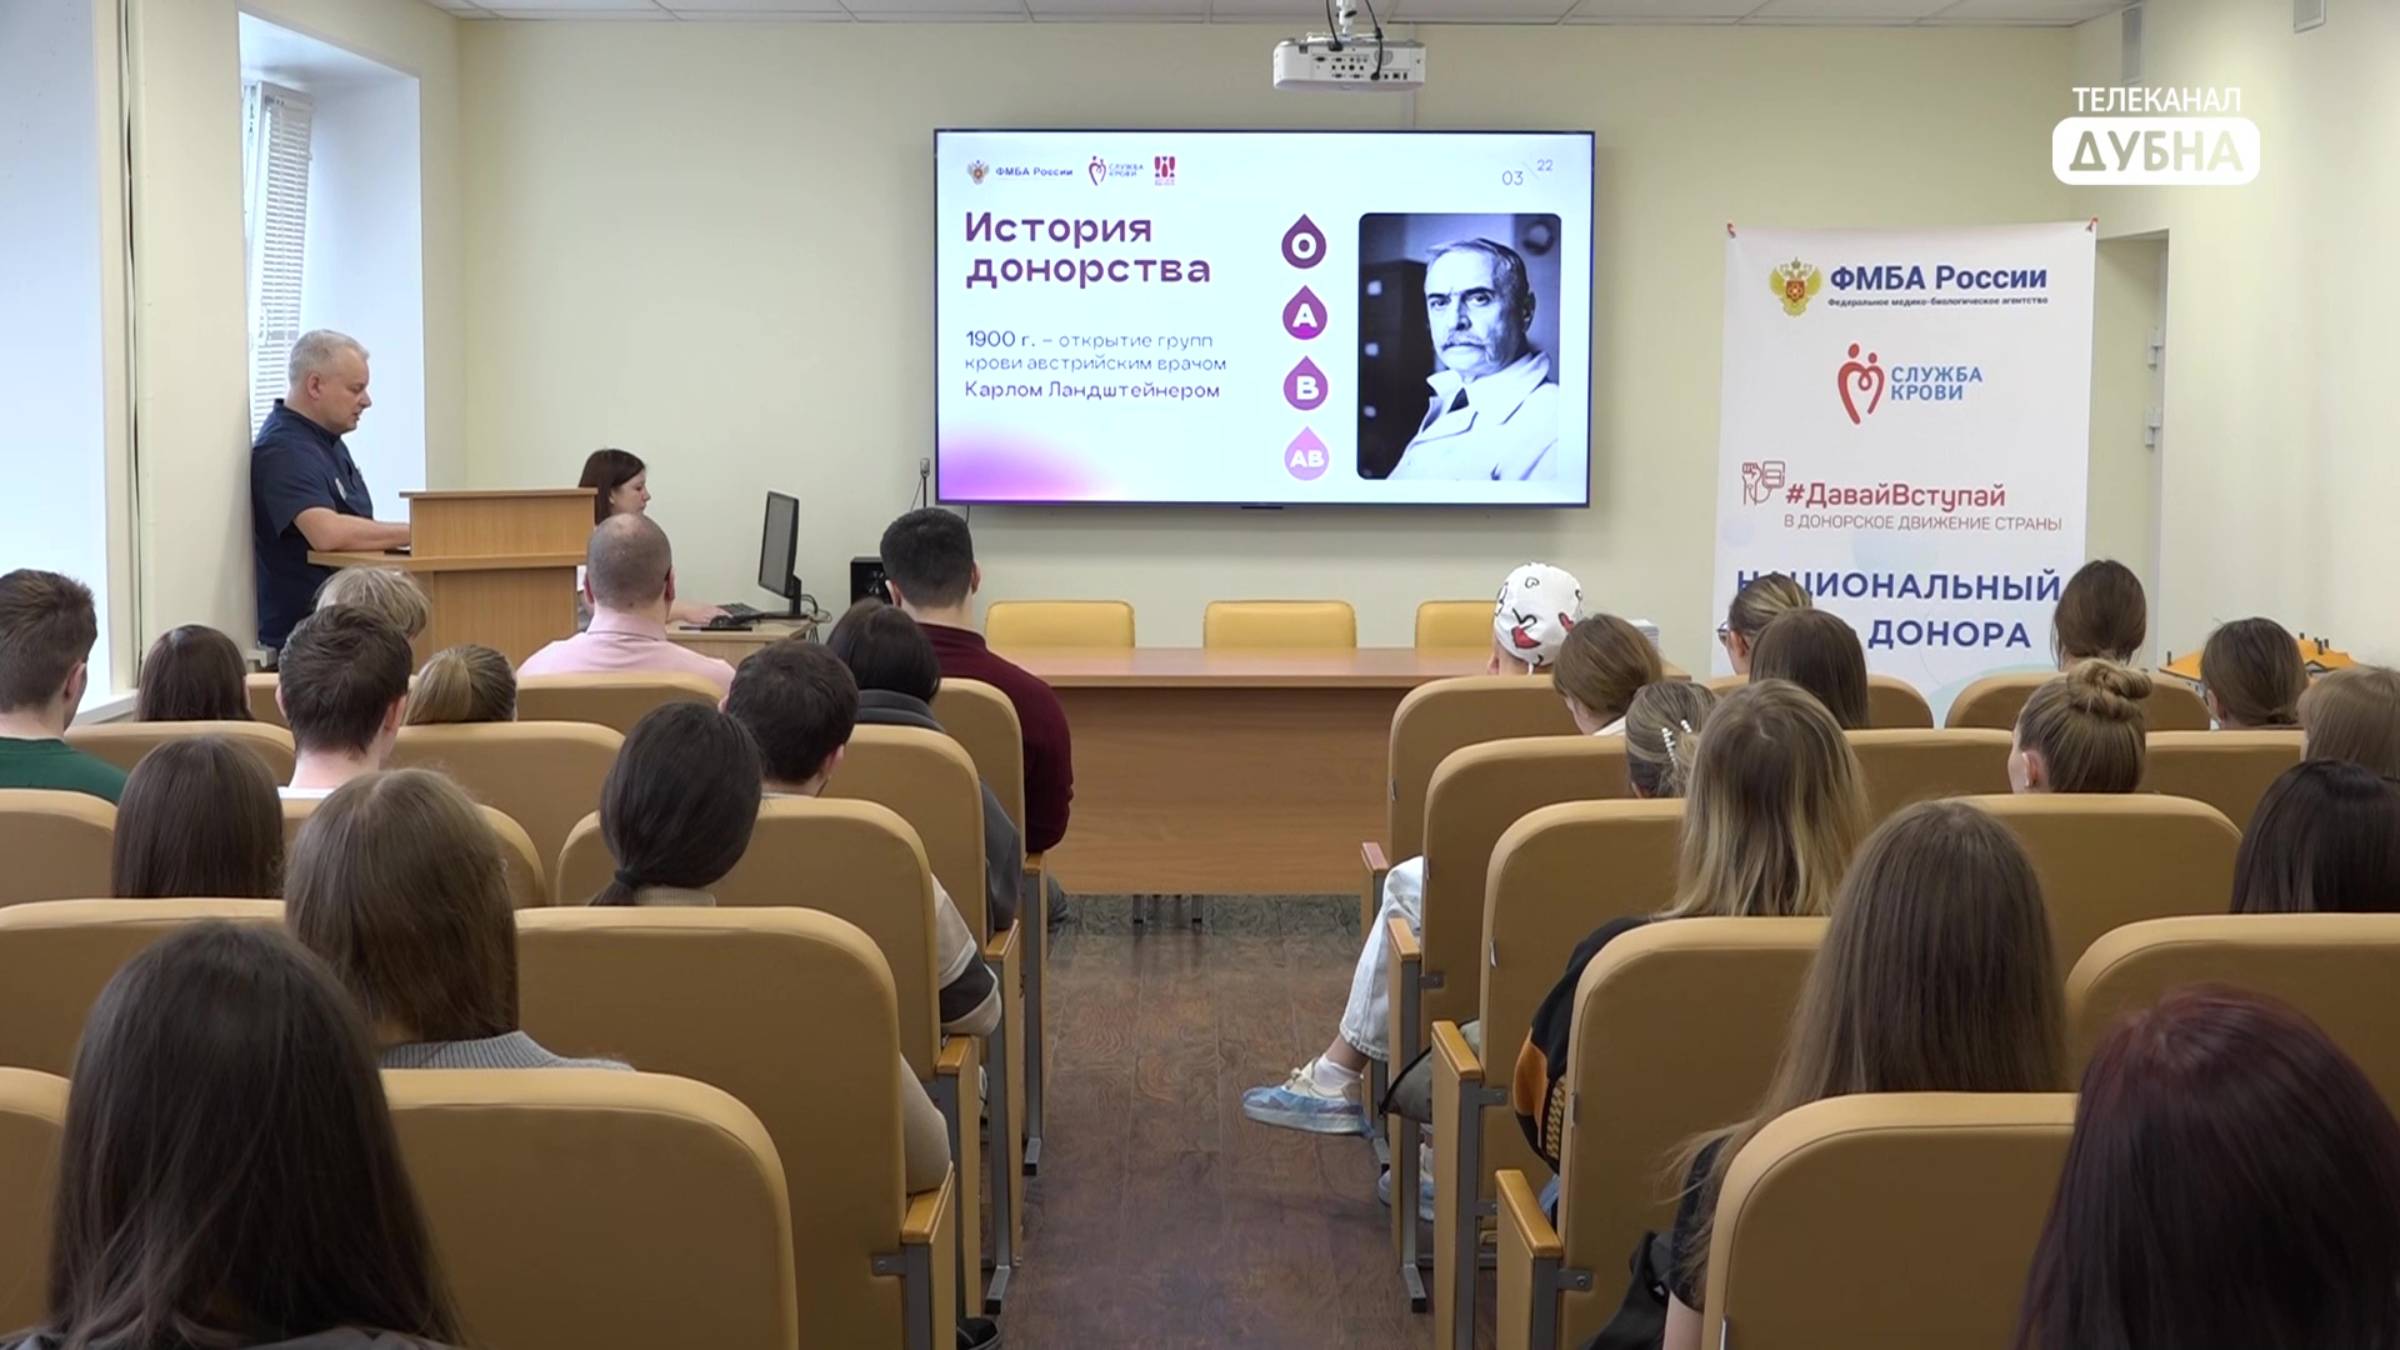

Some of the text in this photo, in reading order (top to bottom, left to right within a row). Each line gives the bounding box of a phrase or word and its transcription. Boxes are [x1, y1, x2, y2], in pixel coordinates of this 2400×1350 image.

[996, 166, 1073, 177] ФМБА России
[1537, 159, 1553, 171] 22
[1502, 170, 1524, 186] 03
[965, 211, 1152, 249] История
[966, 258, 1211, 289] донорства
[1830, 265, 2047, 291] ФМБА России
[1828, 297, 1889, 308] Федеральное
[966, 330, 1016, 348] 1900
[1021, 335, 1036, 348] г.
[1058, 334, 1152, 352] открытие
[1158, 336, 1214, 351] групп
[965, 353, 1227, 373] крови австрийским врачом
[1891, 366, 1983, 384] СЛУЖБА
[965, 380, 1220, 400] Карлом Ландштейнером
[1891, 384, 1963, 400] КРОВИ
[1786, 482, 2006, 511] #ДавайВступай
[1784, 514, 2062, 531] В ДОНОРСКОЕ ДВИЖЕНИЕ СТРАНЫ
[1868, 620, 2031, 649] ДОНОРА
